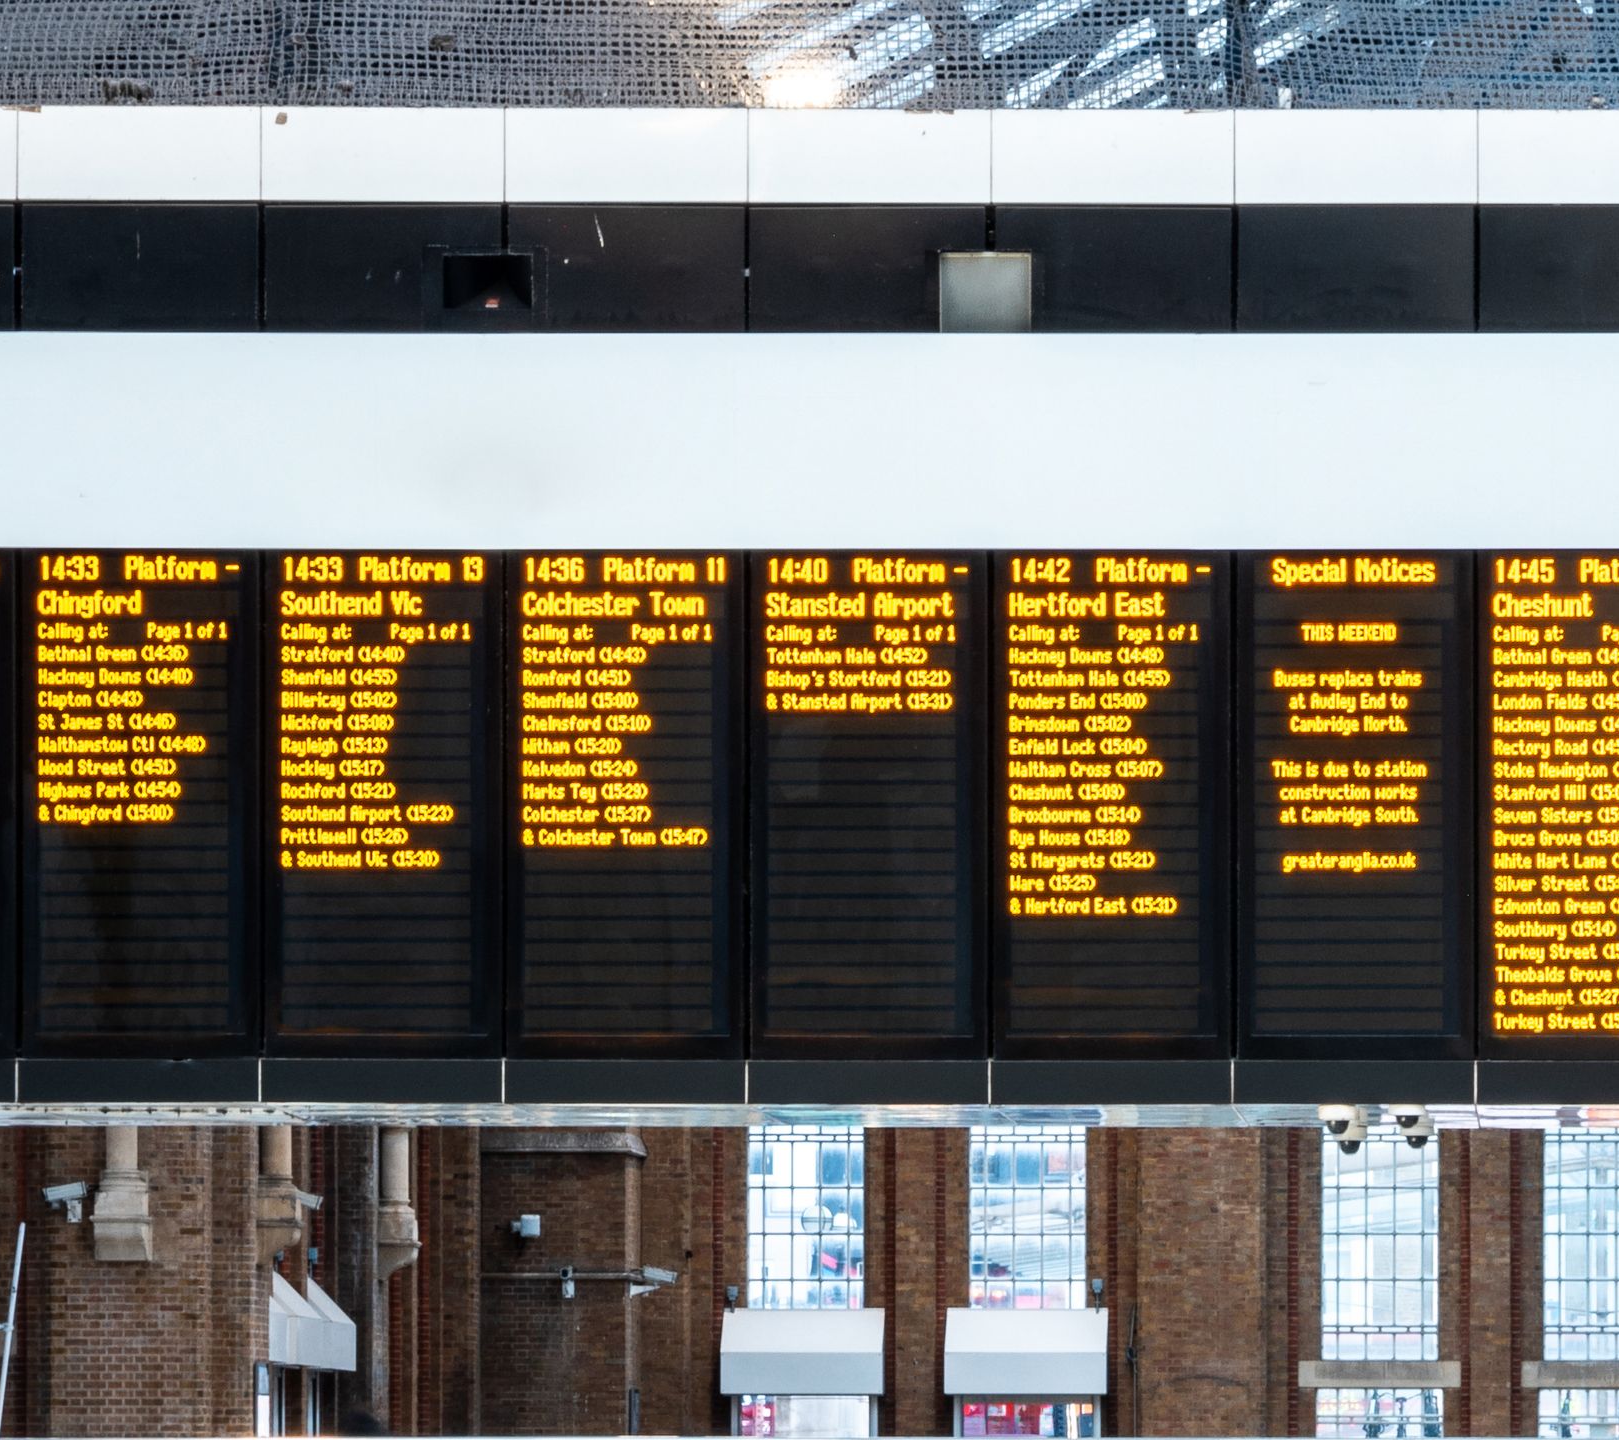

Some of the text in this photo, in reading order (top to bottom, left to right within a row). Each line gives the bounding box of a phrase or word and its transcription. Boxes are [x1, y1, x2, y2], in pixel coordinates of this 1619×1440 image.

[283, 556, 484, 582] 14:33 Platform 13
[525, 556, 725, 583] 14:36 Platform 11
[1272, 557, 1436, 587] Special Notices
[280, 590, 423, 616] Southend Vic
[522, 591, 705, 617] Colchester Town
[281, 690, 346, 710] Billericay
[1282, 851, 1417, 873] greateranglia.co.uk
